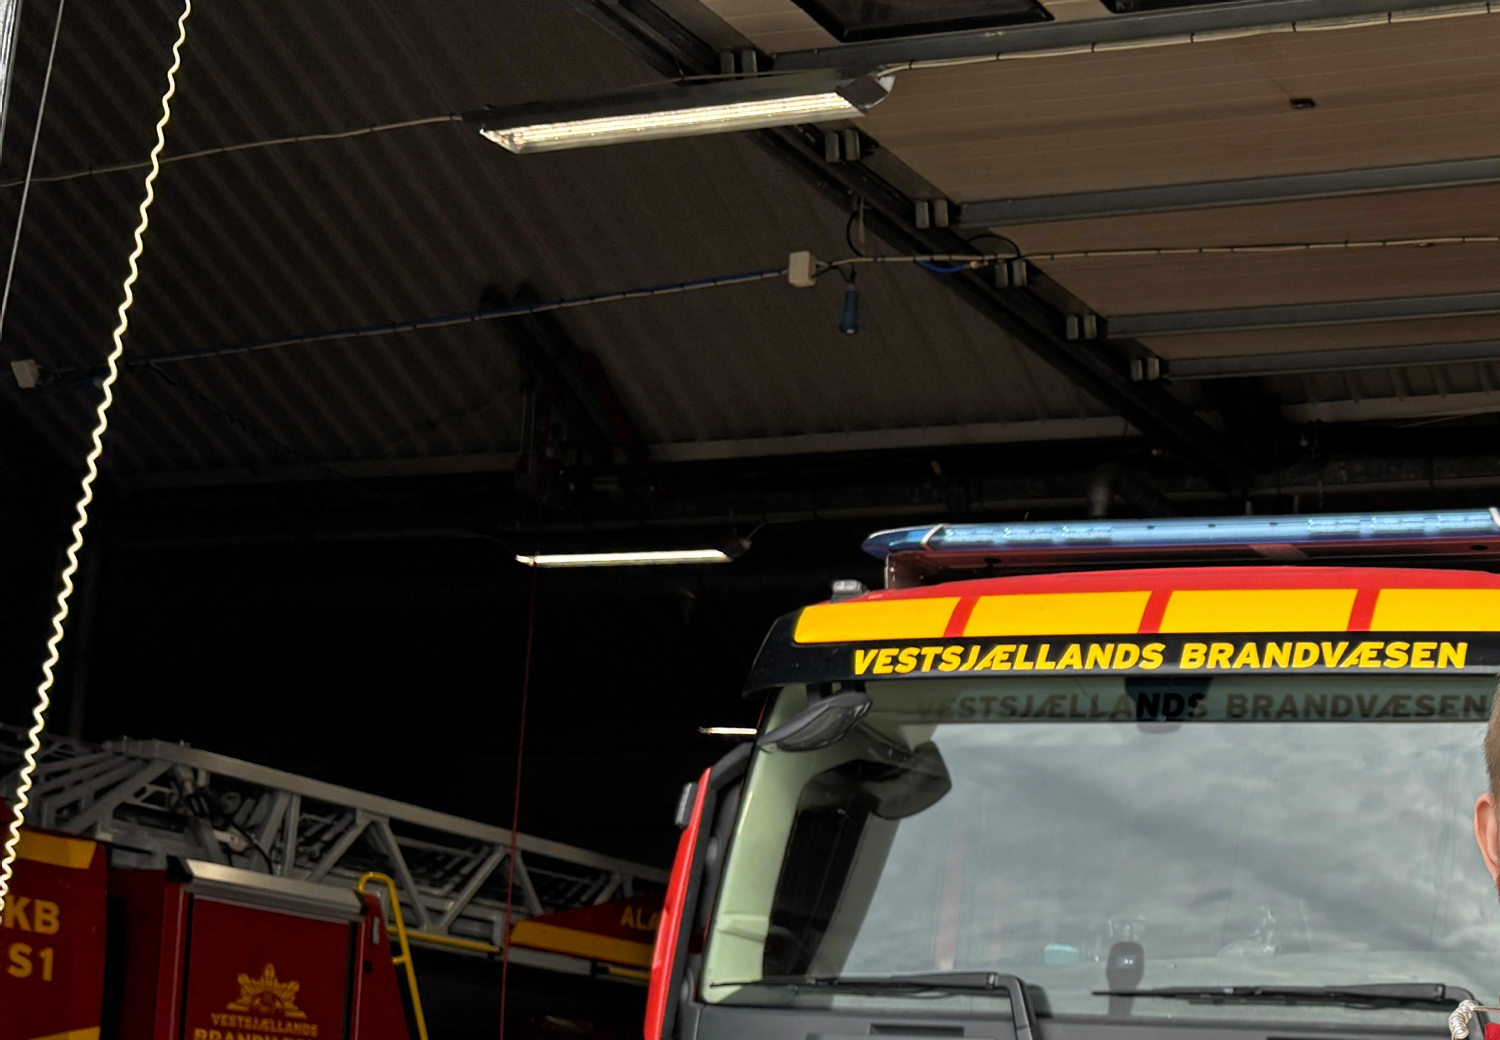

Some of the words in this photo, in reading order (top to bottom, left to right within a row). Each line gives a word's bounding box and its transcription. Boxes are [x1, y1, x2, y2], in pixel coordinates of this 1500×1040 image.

[854, 643, 1166, 675] VESTSJÆLLANDS
[1180, 642, 1467, 669] BRANDVÆSEN
[4, 894, 60, 935] KB
[8, 942, 54, 982] S1
